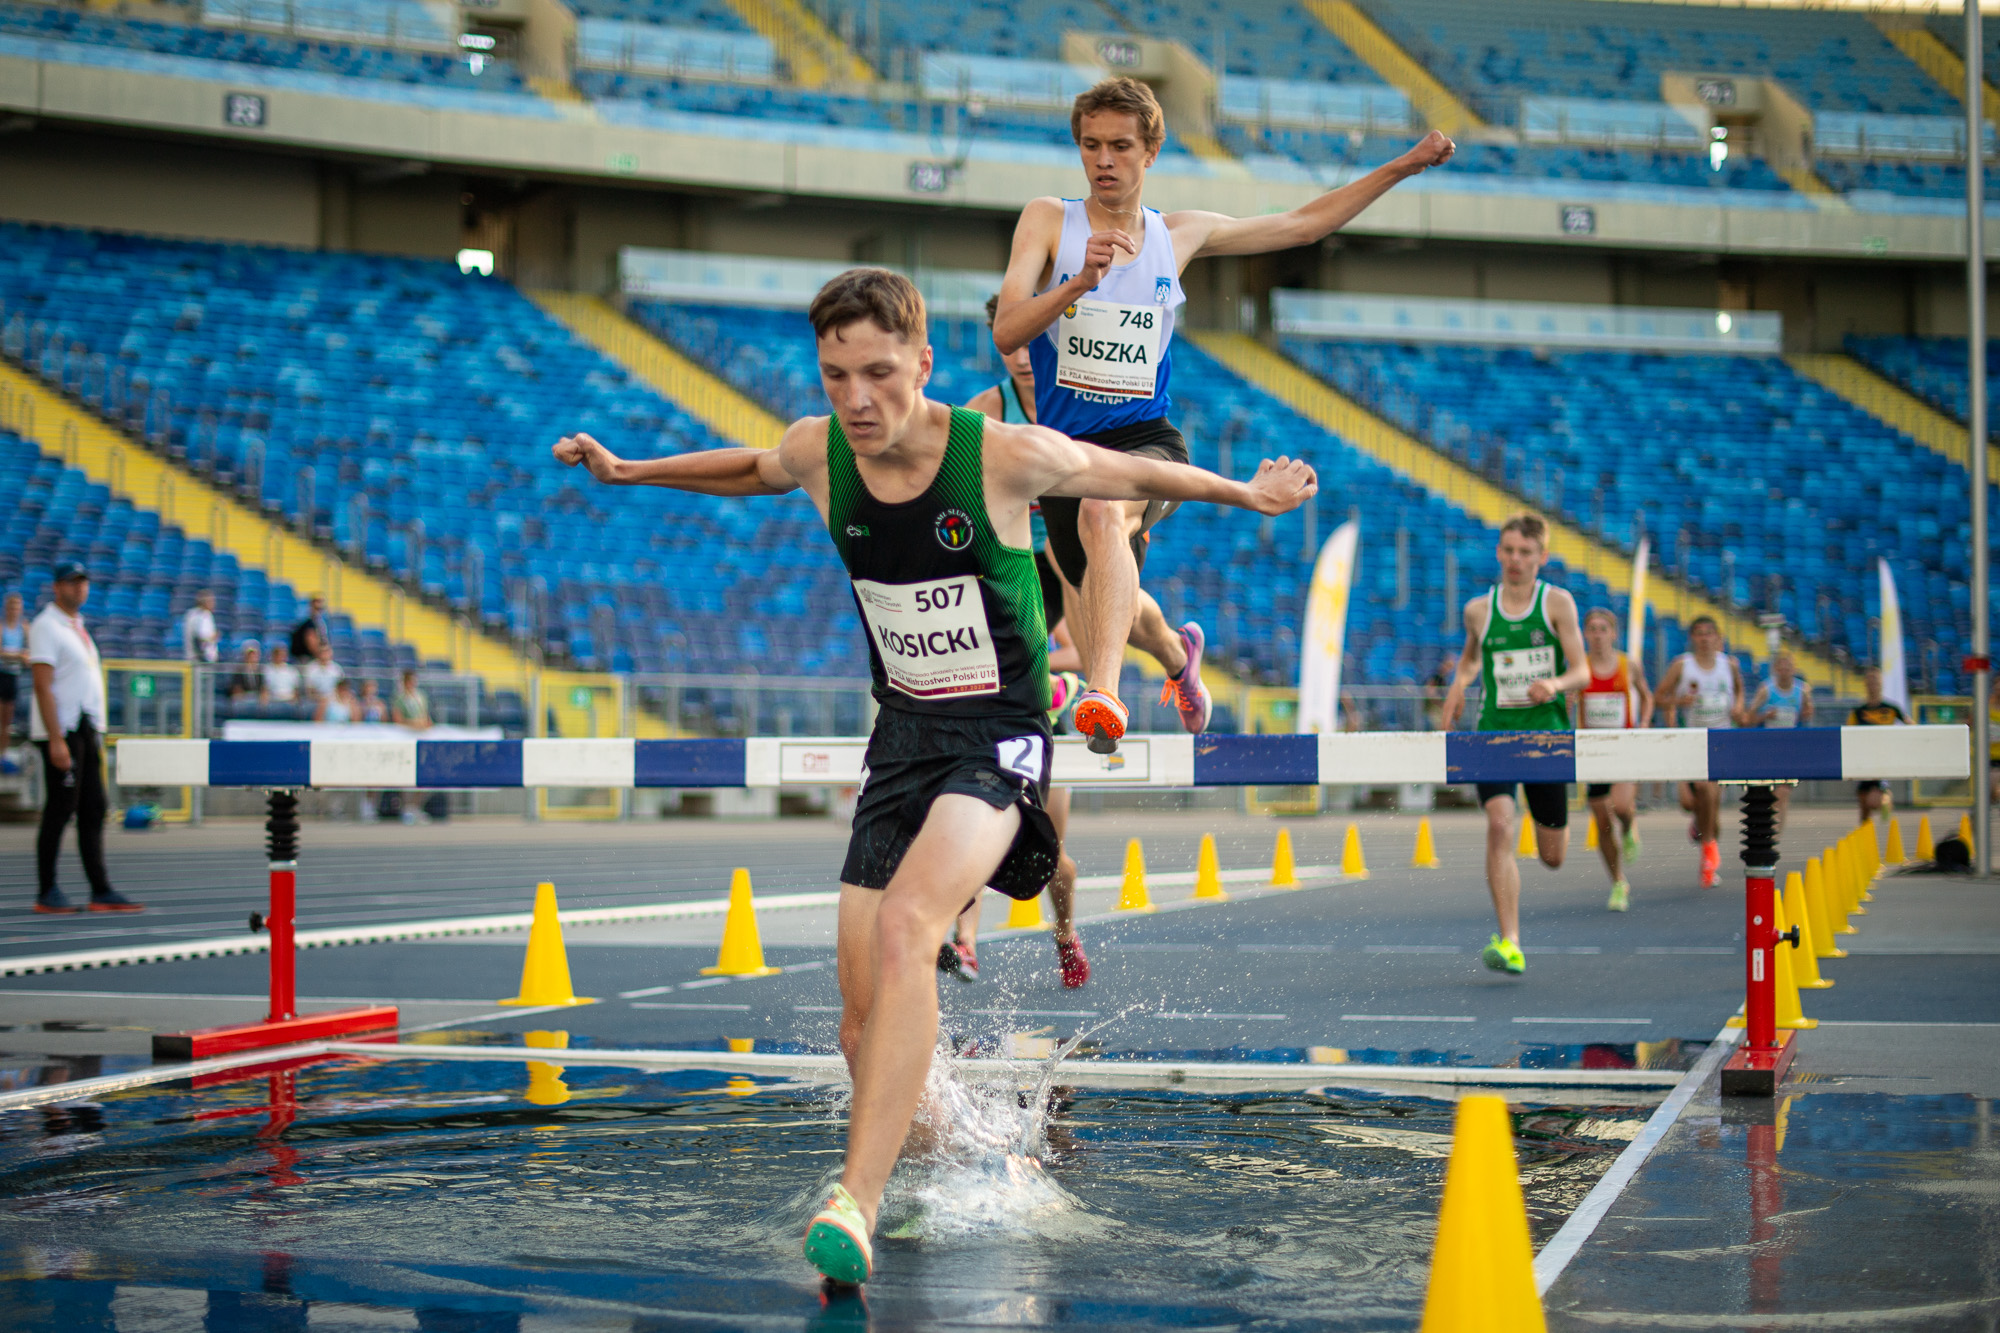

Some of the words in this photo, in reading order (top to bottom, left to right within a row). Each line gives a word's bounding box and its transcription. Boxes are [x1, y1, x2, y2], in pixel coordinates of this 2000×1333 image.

[1119, 309, 1154, 329] 748
[1067, 335, 1148, 364] SUSZKA
[1083, 375, 1120, 386] Mistrzostwa
[1122, 378, 1140, 387] Polski
[914, 583, 965, 613] 507
[877, 625, 980, 658] KOSICKI
[906, 676, 951, 687] Mistrzostwa
[953, 671, 978, 682] Polski
[980, 669, 996, 679] U18
[1009, 737, 1034, 775] 2
